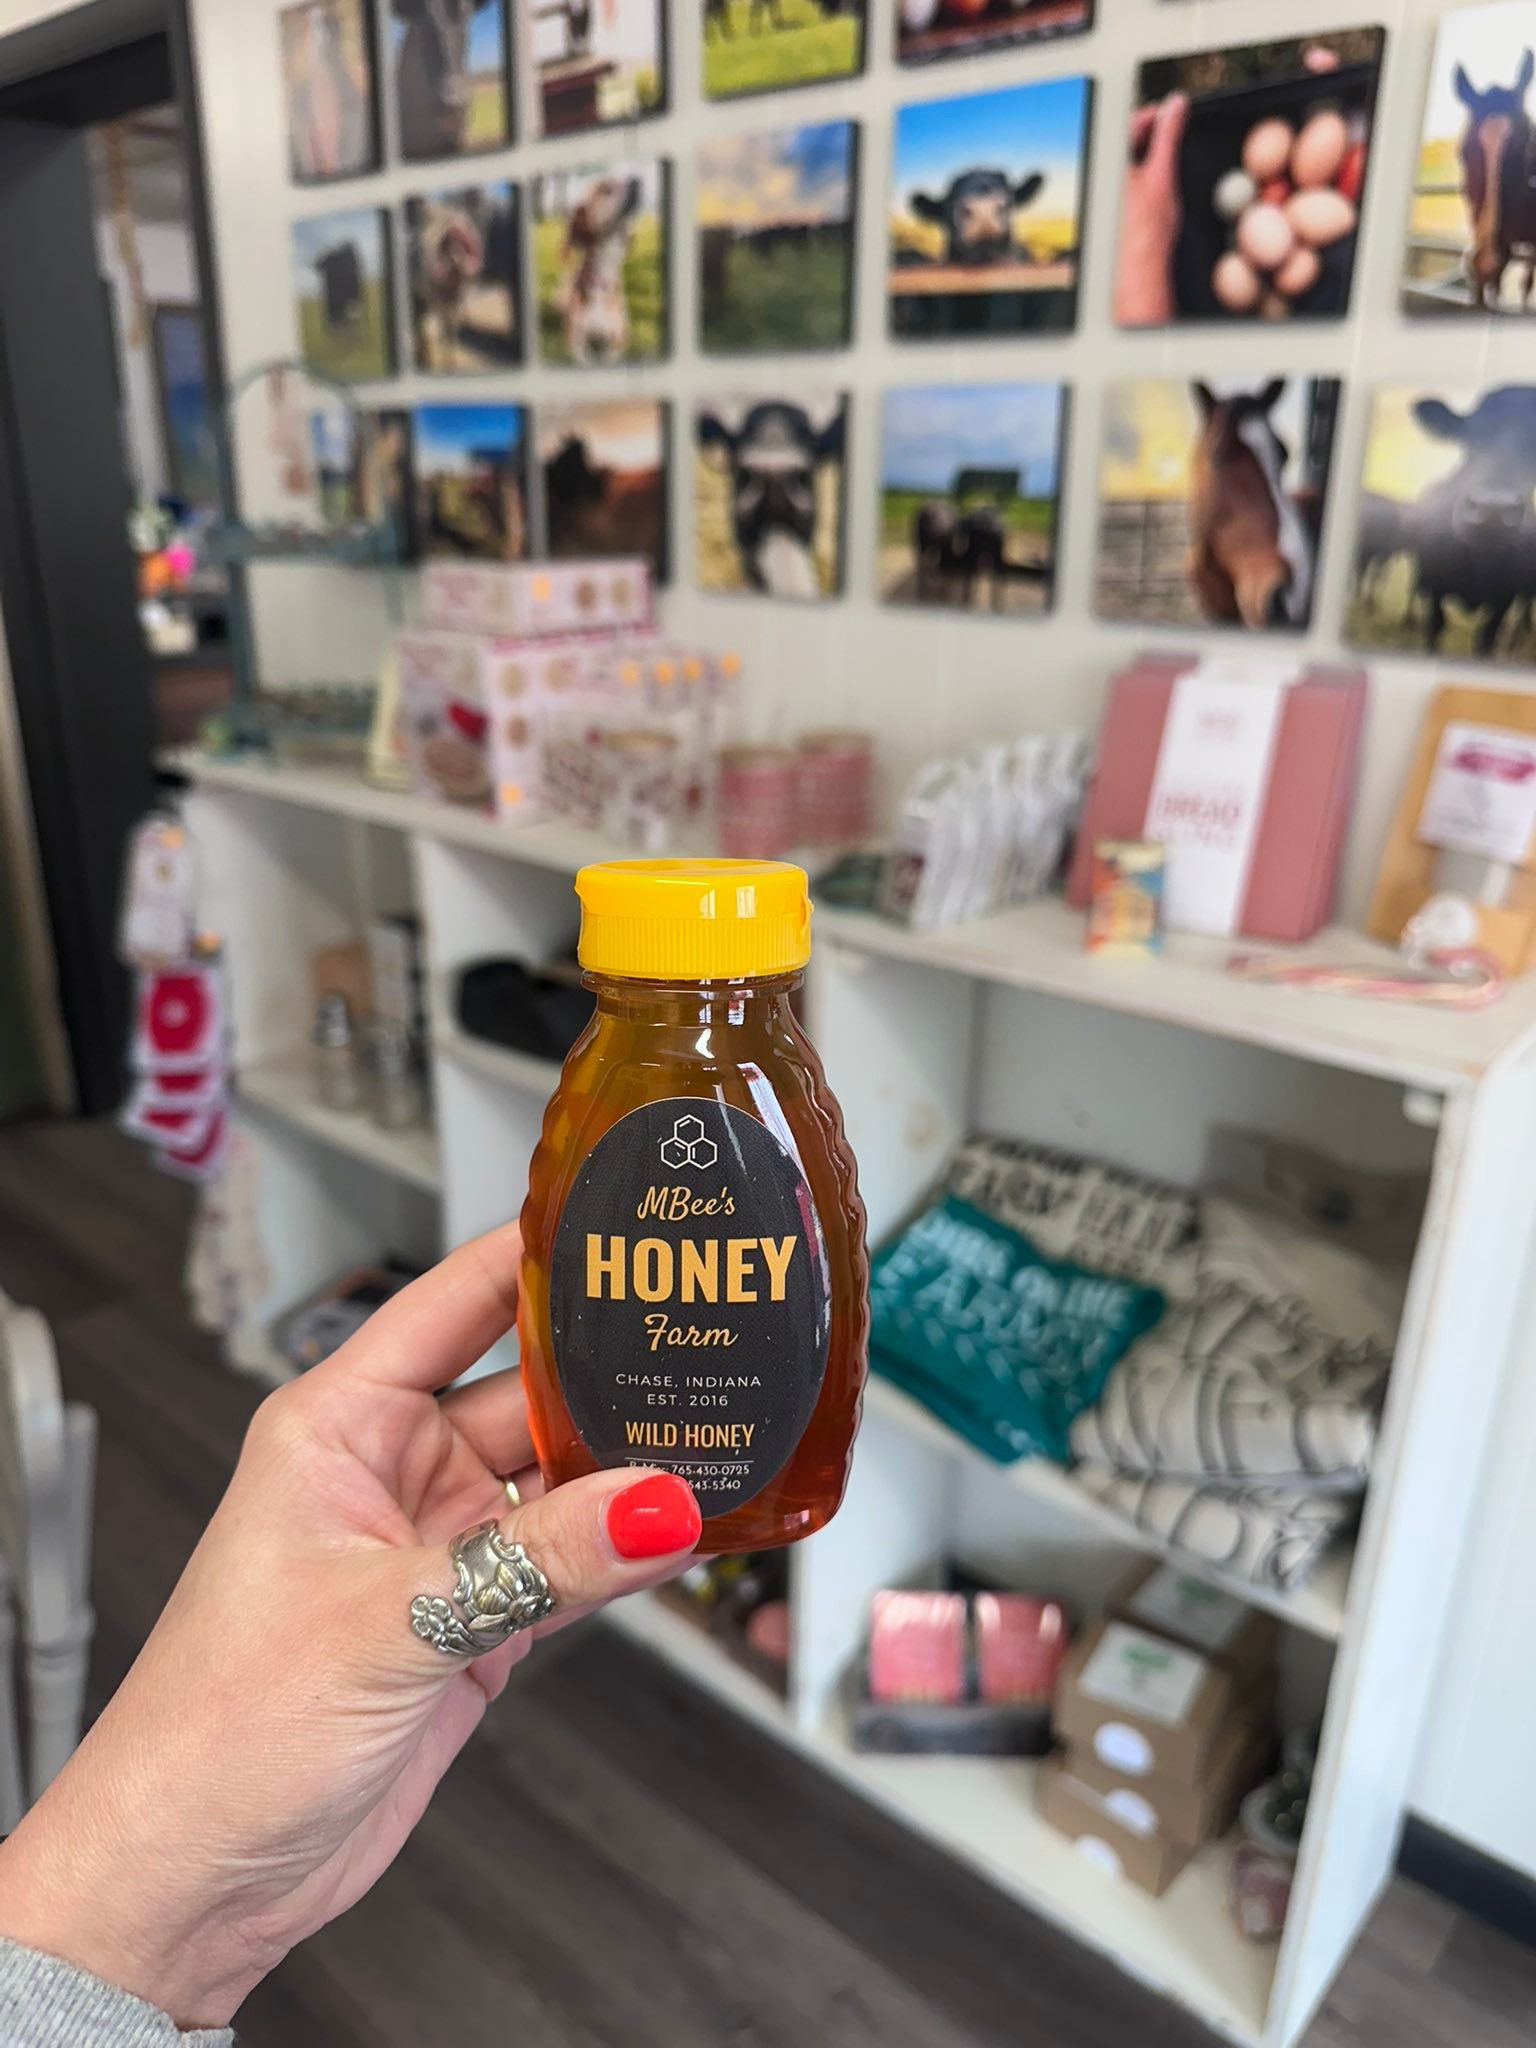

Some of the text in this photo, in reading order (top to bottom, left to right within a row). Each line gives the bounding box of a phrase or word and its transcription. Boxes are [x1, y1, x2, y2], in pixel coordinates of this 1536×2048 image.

[636, 1185, 736, 1222] MBee's
[586, 1233, 798, 1304] HONEY
[643, 1312, 739, 1351] Farm
[615, 1373, 762, 1388] CHASE, INDIANA
[647, 1393, 729, 1407] EST. 2016
[625, 1421, 755, 1448] WILD HONEY
